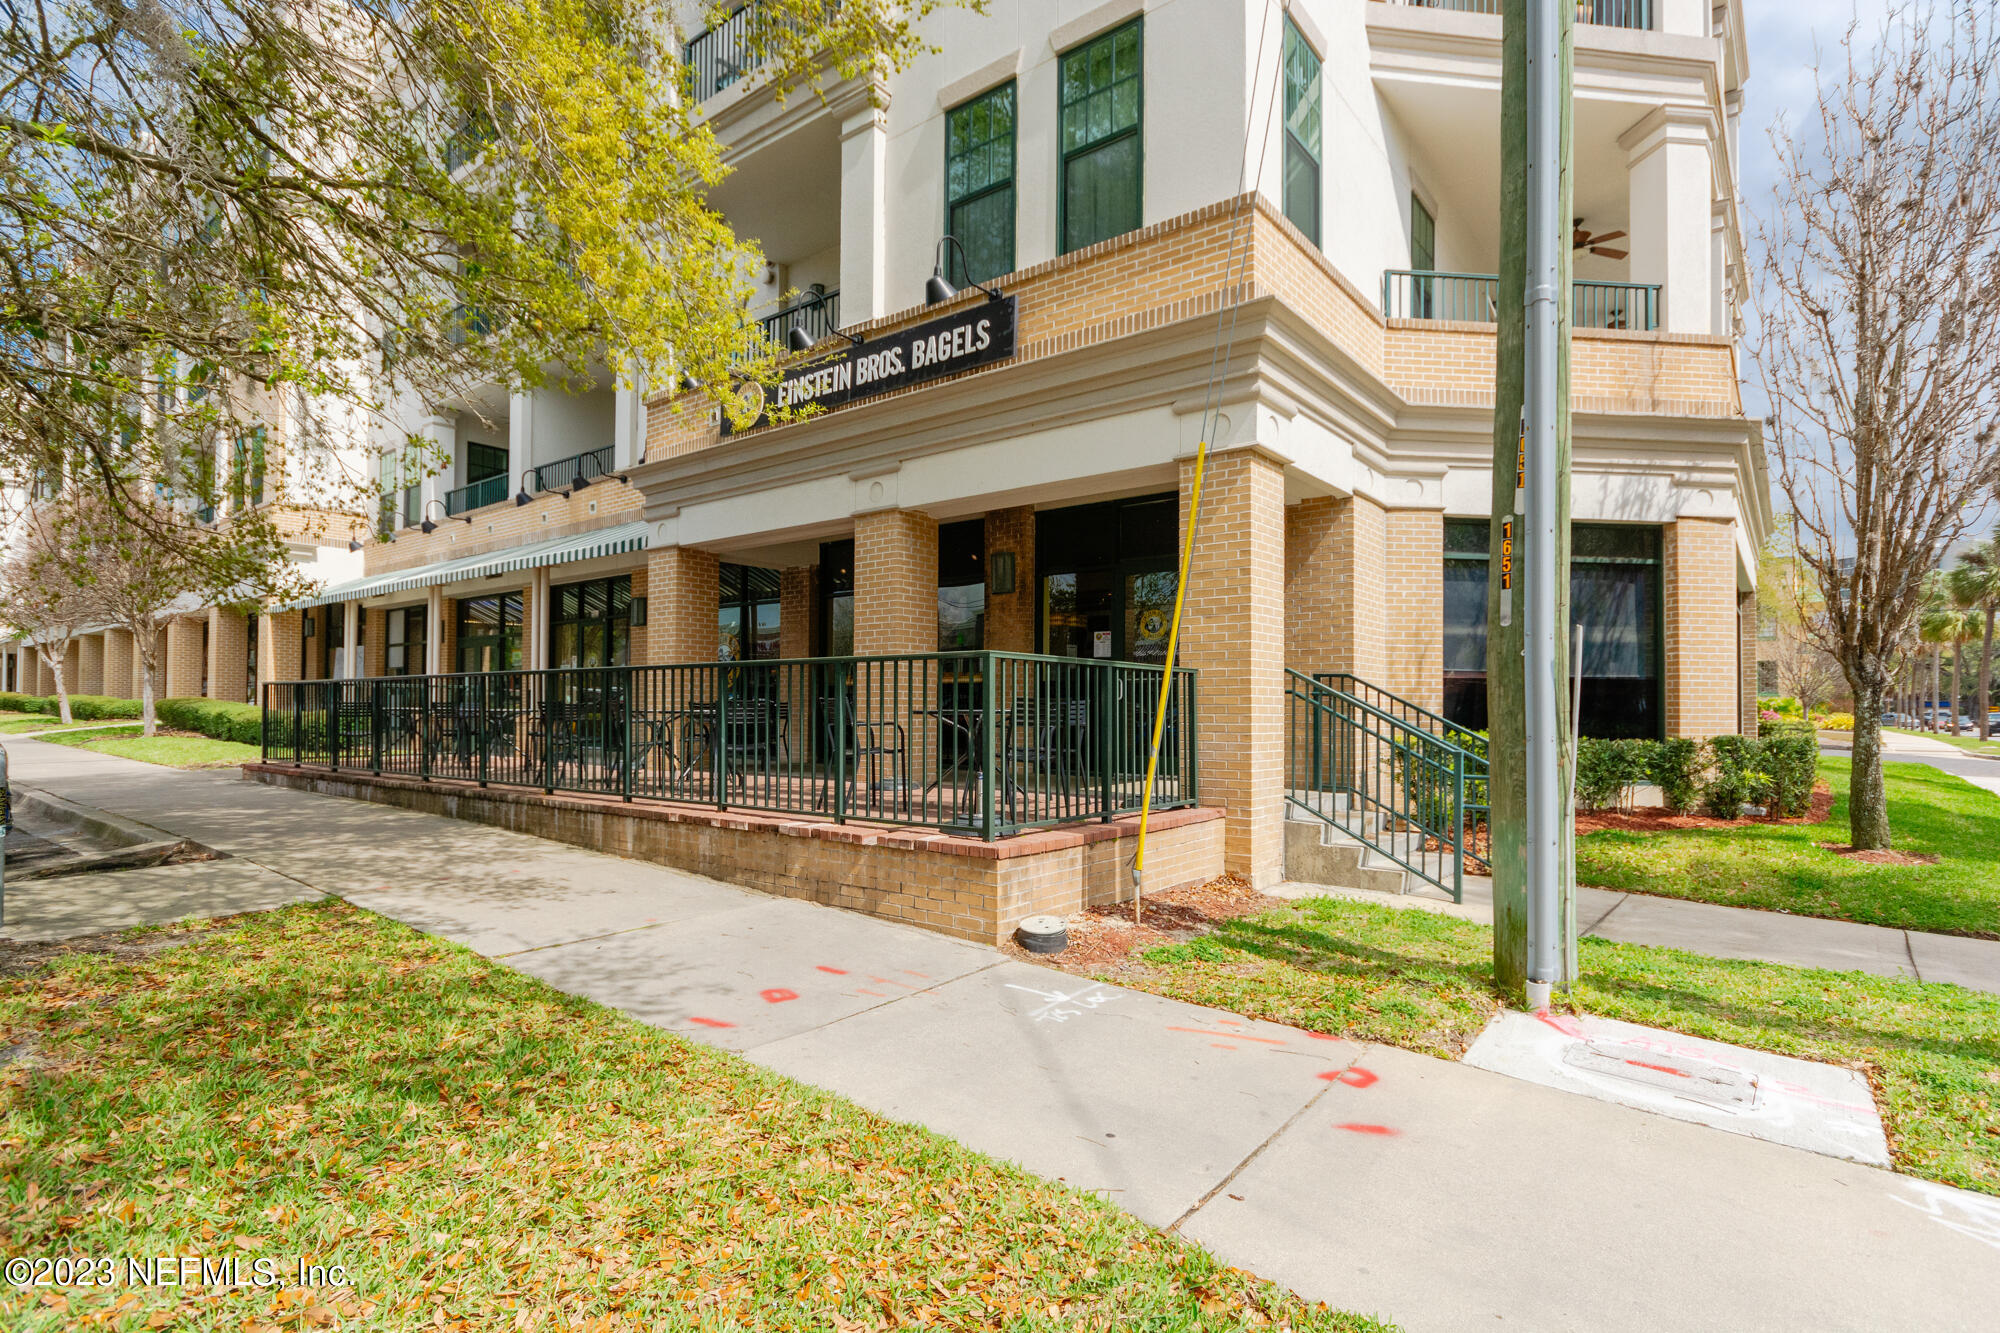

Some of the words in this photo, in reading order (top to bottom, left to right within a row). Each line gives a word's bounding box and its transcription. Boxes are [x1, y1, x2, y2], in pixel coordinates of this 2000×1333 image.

[777, 361, 852, 409] EINSTEIN
[856, 347, 905, 387] BROS.
[912, 319, 991, 370] BAGELS
[1502, 522, 1513, 589] 1651
